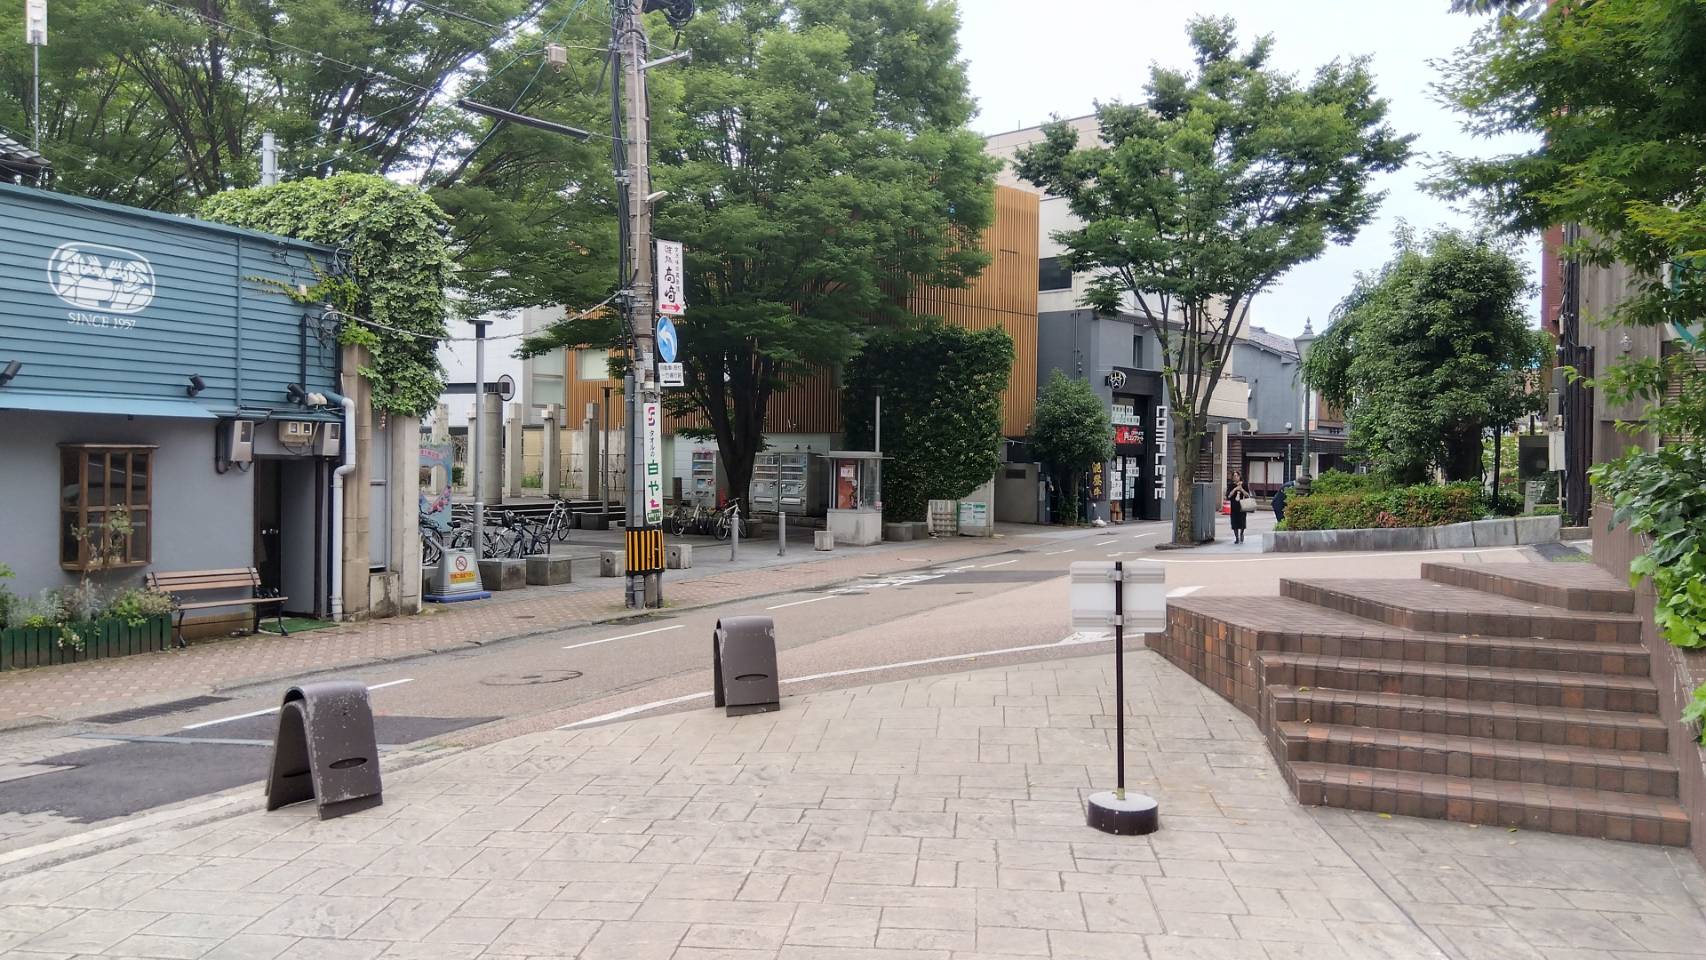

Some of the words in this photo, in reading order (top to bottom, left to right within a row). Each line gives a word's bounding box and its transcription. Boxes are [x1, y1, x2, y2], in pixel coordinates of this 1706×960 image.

[67, 311, 110, 329] SINCE
[112, 317, 136, 330] 1957
[1154, 405, 1168, 500] COMPLETE
